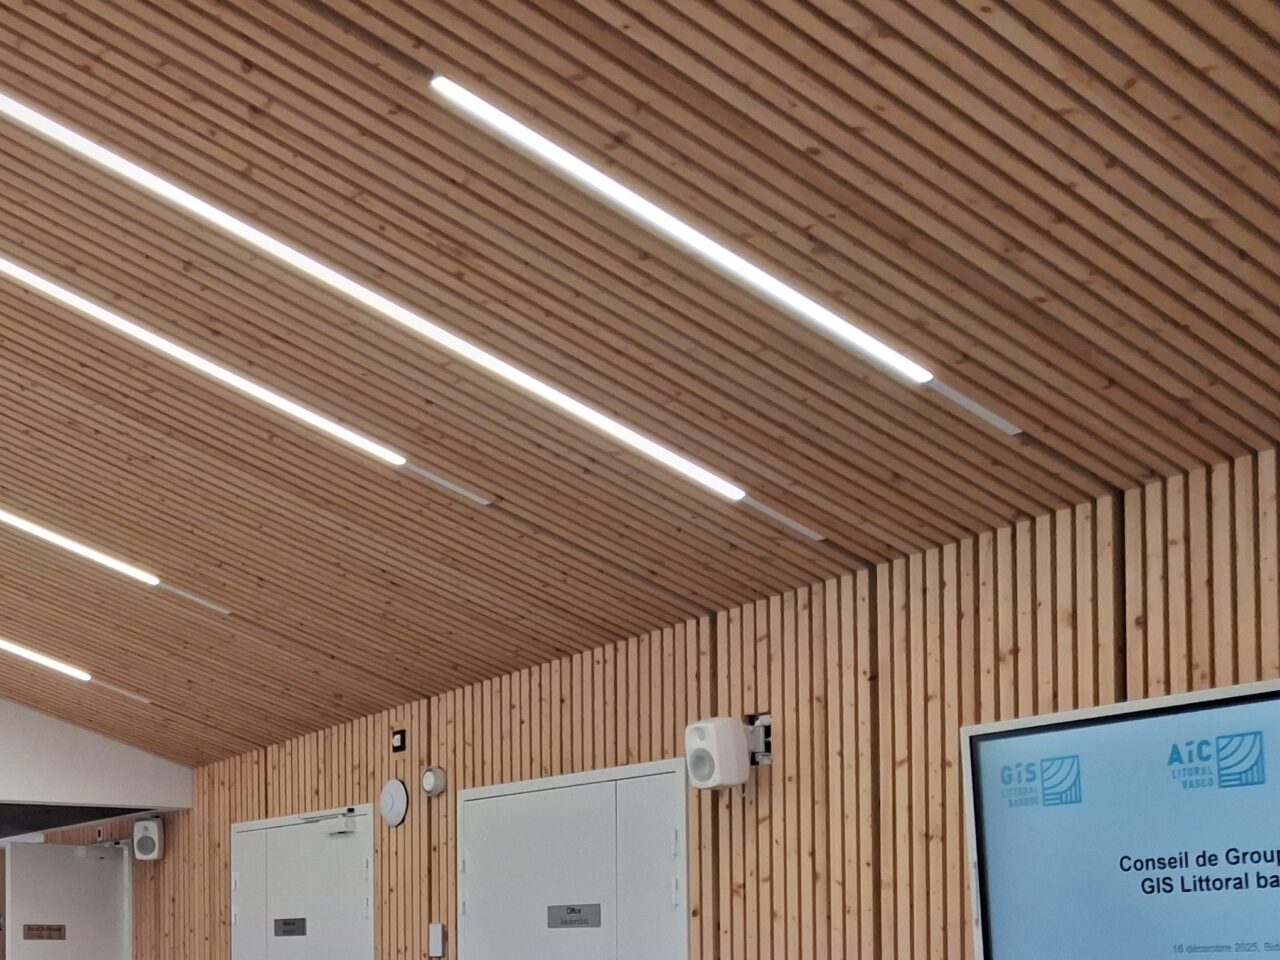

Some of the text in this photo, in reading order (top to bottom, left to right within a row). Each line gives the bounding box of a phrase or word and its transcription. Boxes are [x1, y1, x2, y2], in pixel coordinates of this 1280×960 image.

[1119, 851, 1189, 872] Conseil
[1195, 850, 1218, 868] de
[1141, 876, 1174, 895] GIS
[1181, 872, 1249, 892] Littoral
